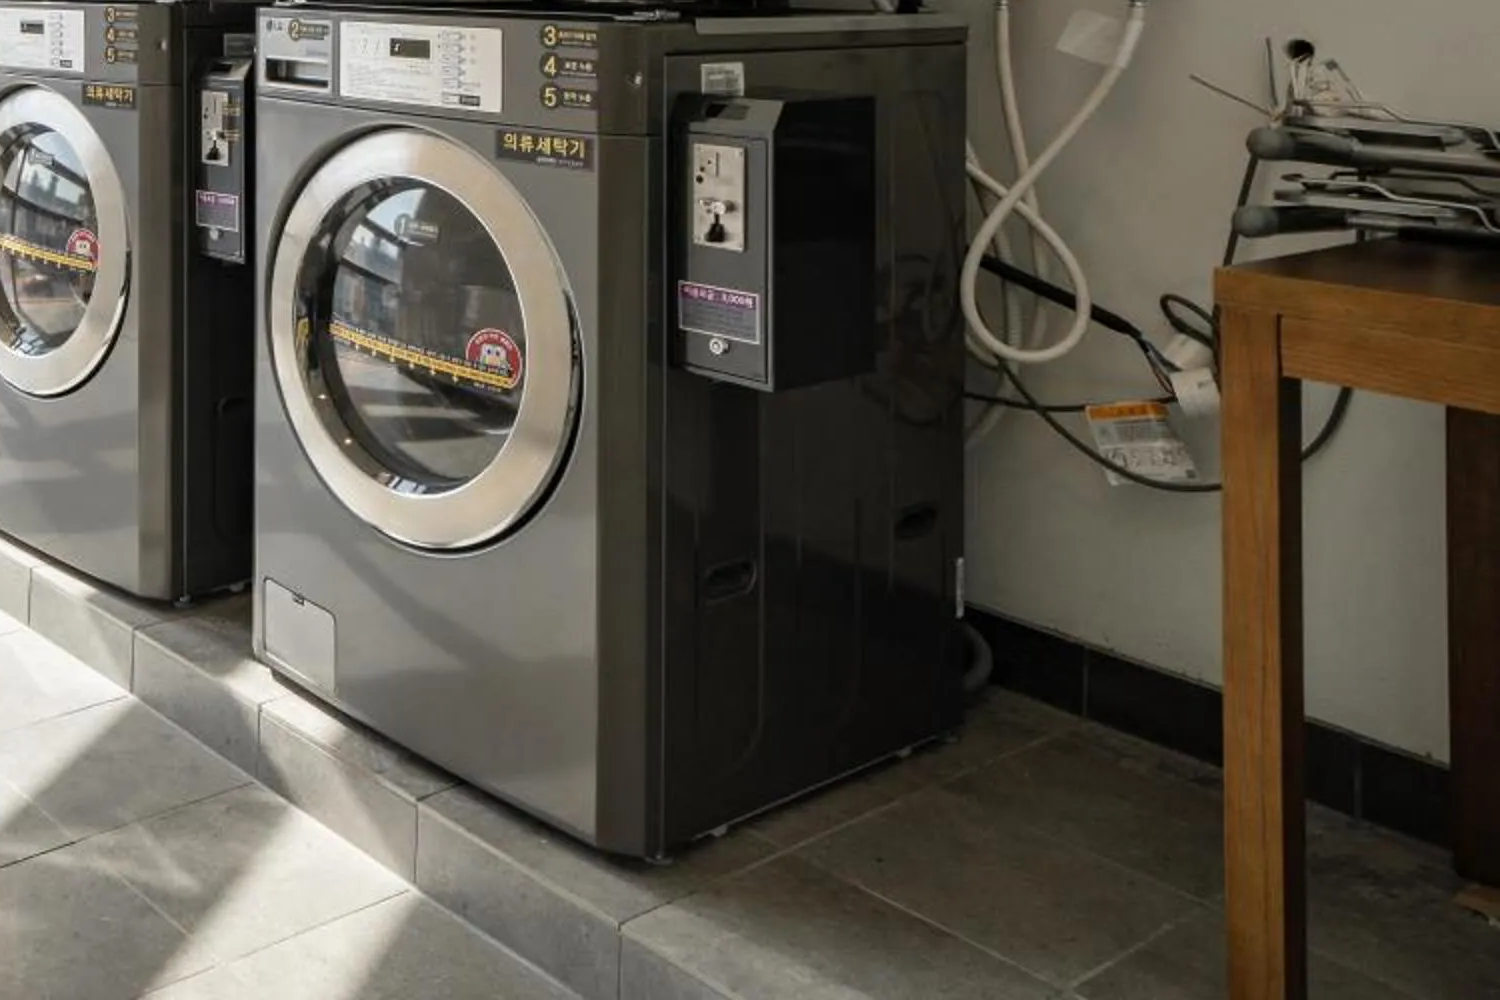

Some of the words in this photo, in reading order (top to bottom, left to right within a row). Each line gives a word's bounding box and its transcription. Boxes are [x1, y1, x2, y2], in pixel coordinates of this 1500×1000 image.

[291, 21, 300, 39] 2
[543, 25, 557, 46] 3
[543, 55, 557, 77] 4
[544, 87, 557, 107] 5
[503, 132, 585, 159] 의류세탁기
